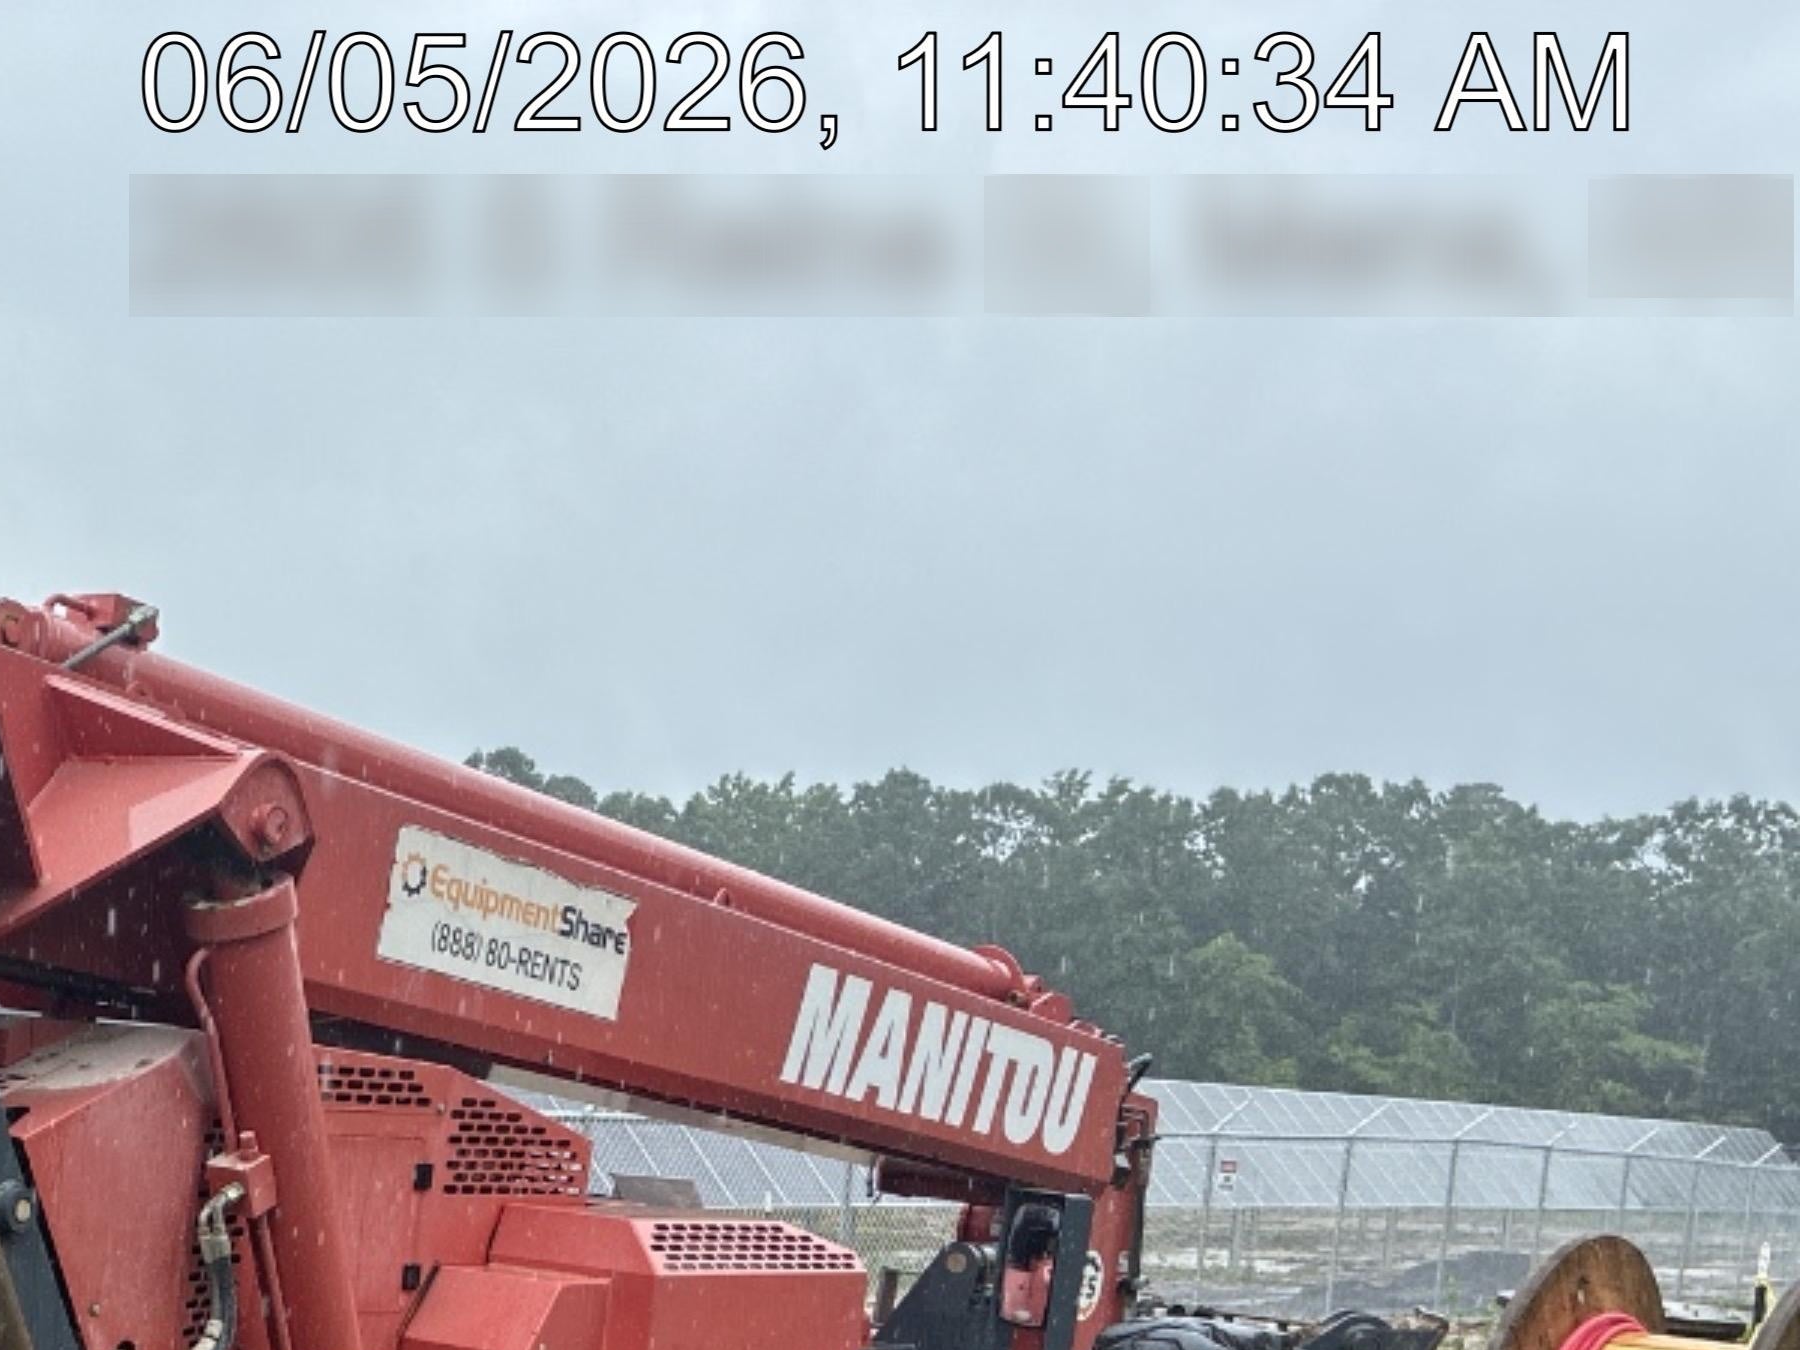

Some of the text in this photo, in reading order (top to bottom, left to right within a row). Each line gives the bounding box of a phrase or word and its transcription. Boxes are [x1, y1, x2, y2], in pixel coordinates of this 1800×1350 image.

[429, 862, 628, 955] EquipmentShare
[431, 919, 583, 991] (888) 80-RENTS
[779, 962, 1098, 1155] MANITOU
